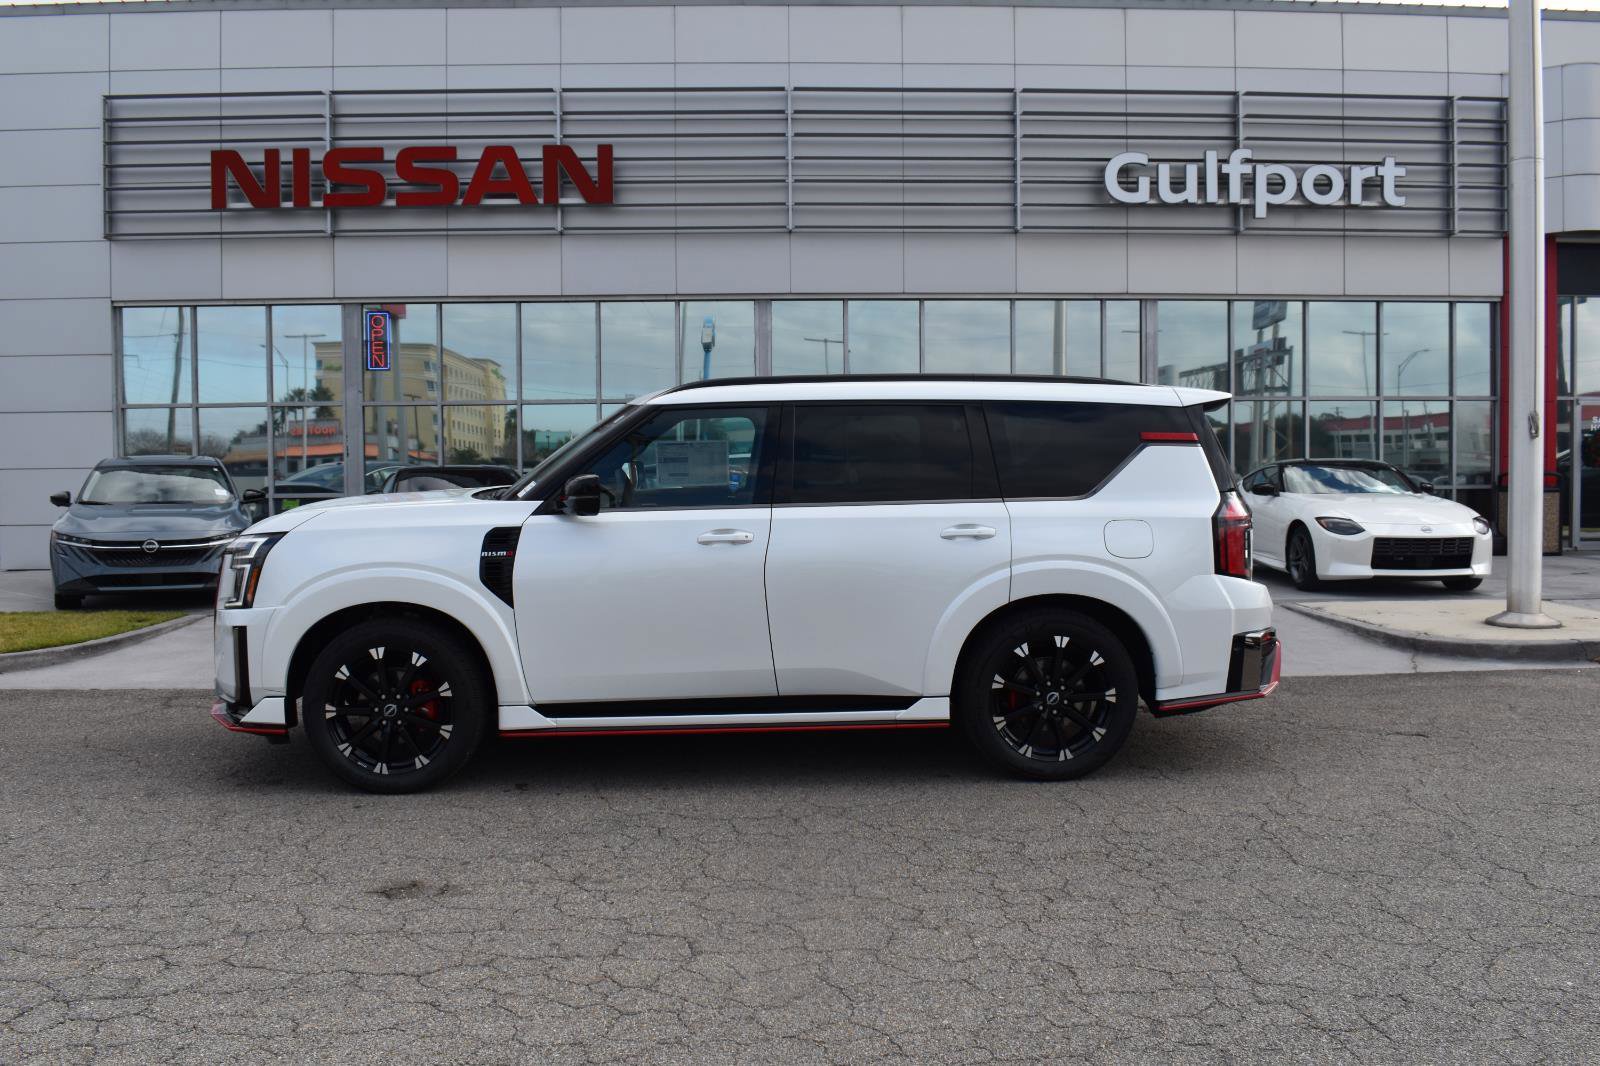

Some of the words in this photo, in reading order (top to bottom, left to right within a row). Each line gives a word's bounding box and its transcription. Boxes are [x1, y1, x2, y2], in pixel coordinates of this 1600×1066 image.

[210, 144, 614, 209] NISSAN
[1104, 148, 1407, 219] Gulfport
[371, 315, 385, 367] OPEN
